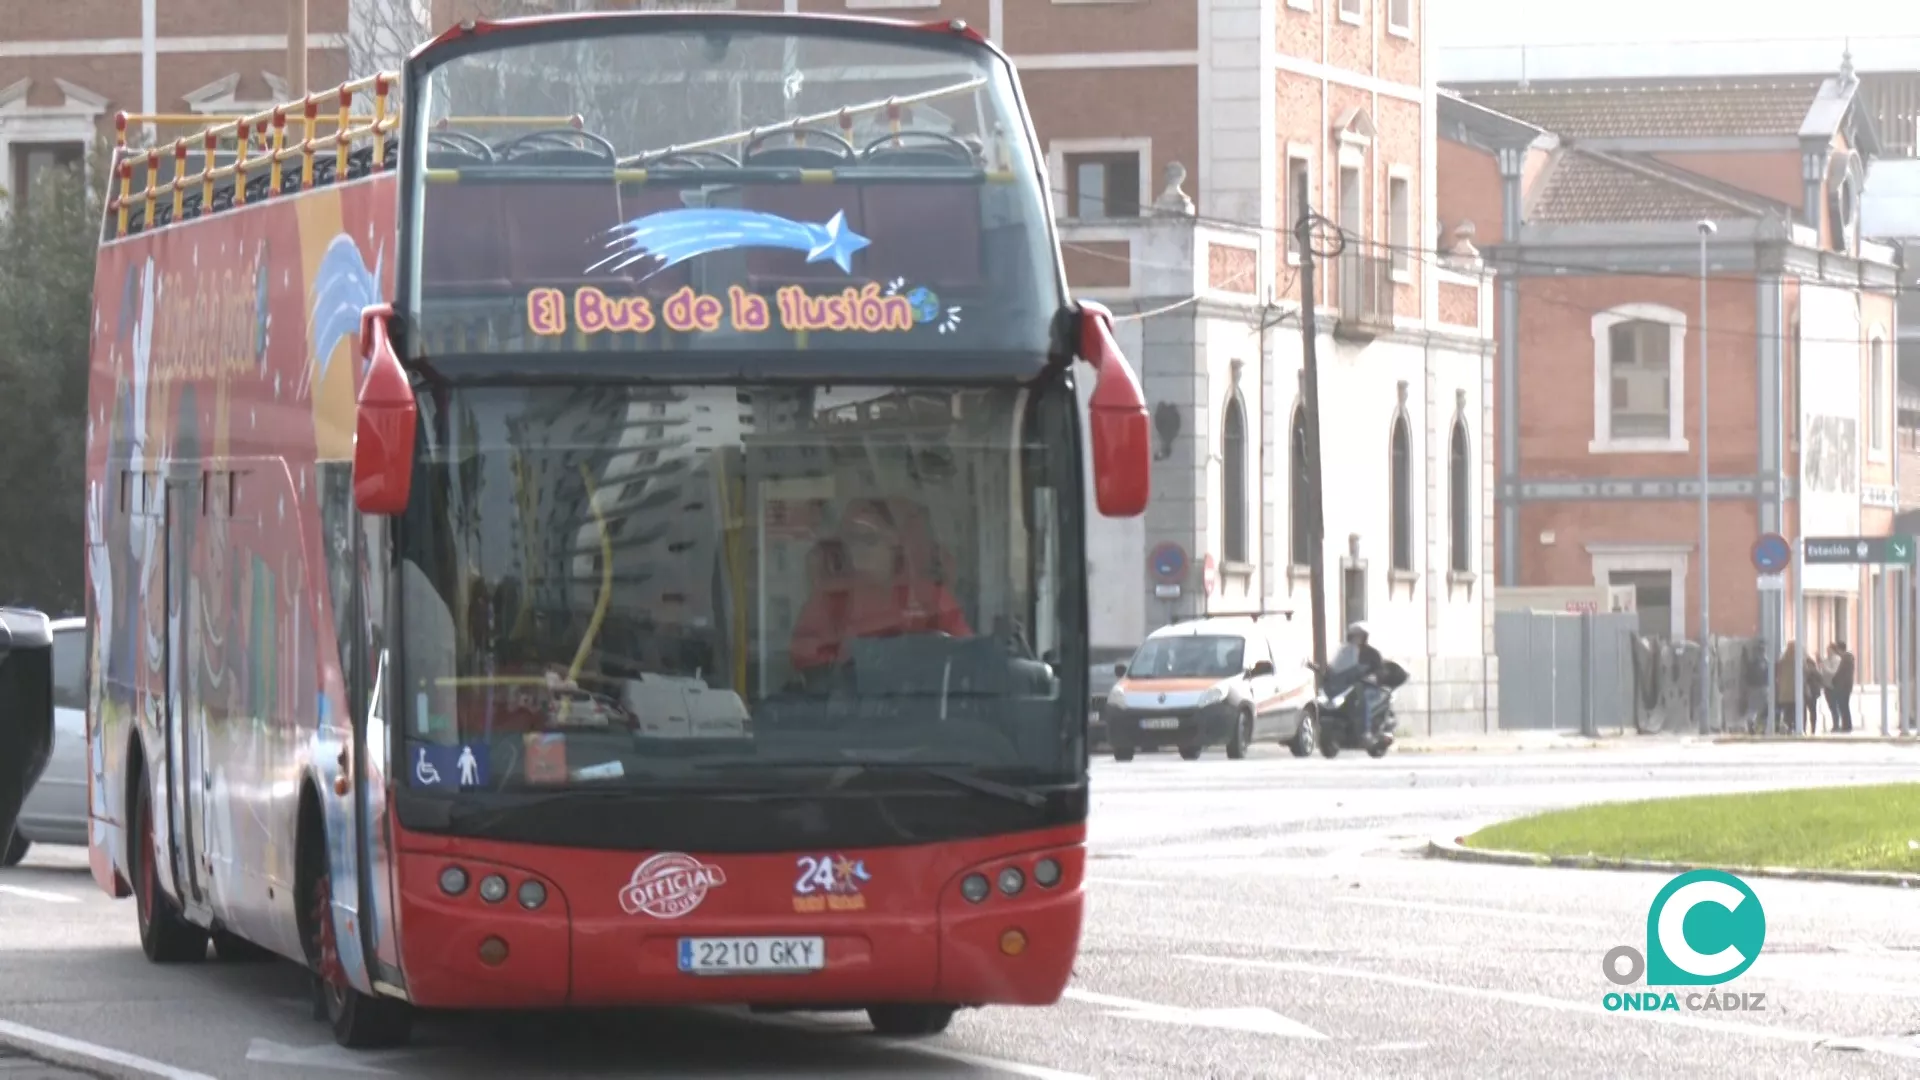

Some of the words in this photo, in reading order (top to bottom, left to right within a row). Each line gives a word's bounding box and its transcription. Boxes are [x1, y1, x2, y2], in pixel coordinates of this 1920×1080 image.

[528, 287, 565, 335] El
[575, 286, 655, 333] Bus
[663, 286, 722, 331] de
[729, 285, 768, 330] la
[779, 281, 913, 332] ilusión
[1808, 543, 1850, 557] Estación
[631, 868, 722, 908] OFFICIAL
[795, 856, 835, 893] 24
[700, 941, 758, 965] 2210
[769, 940, 815, 965] GKY
